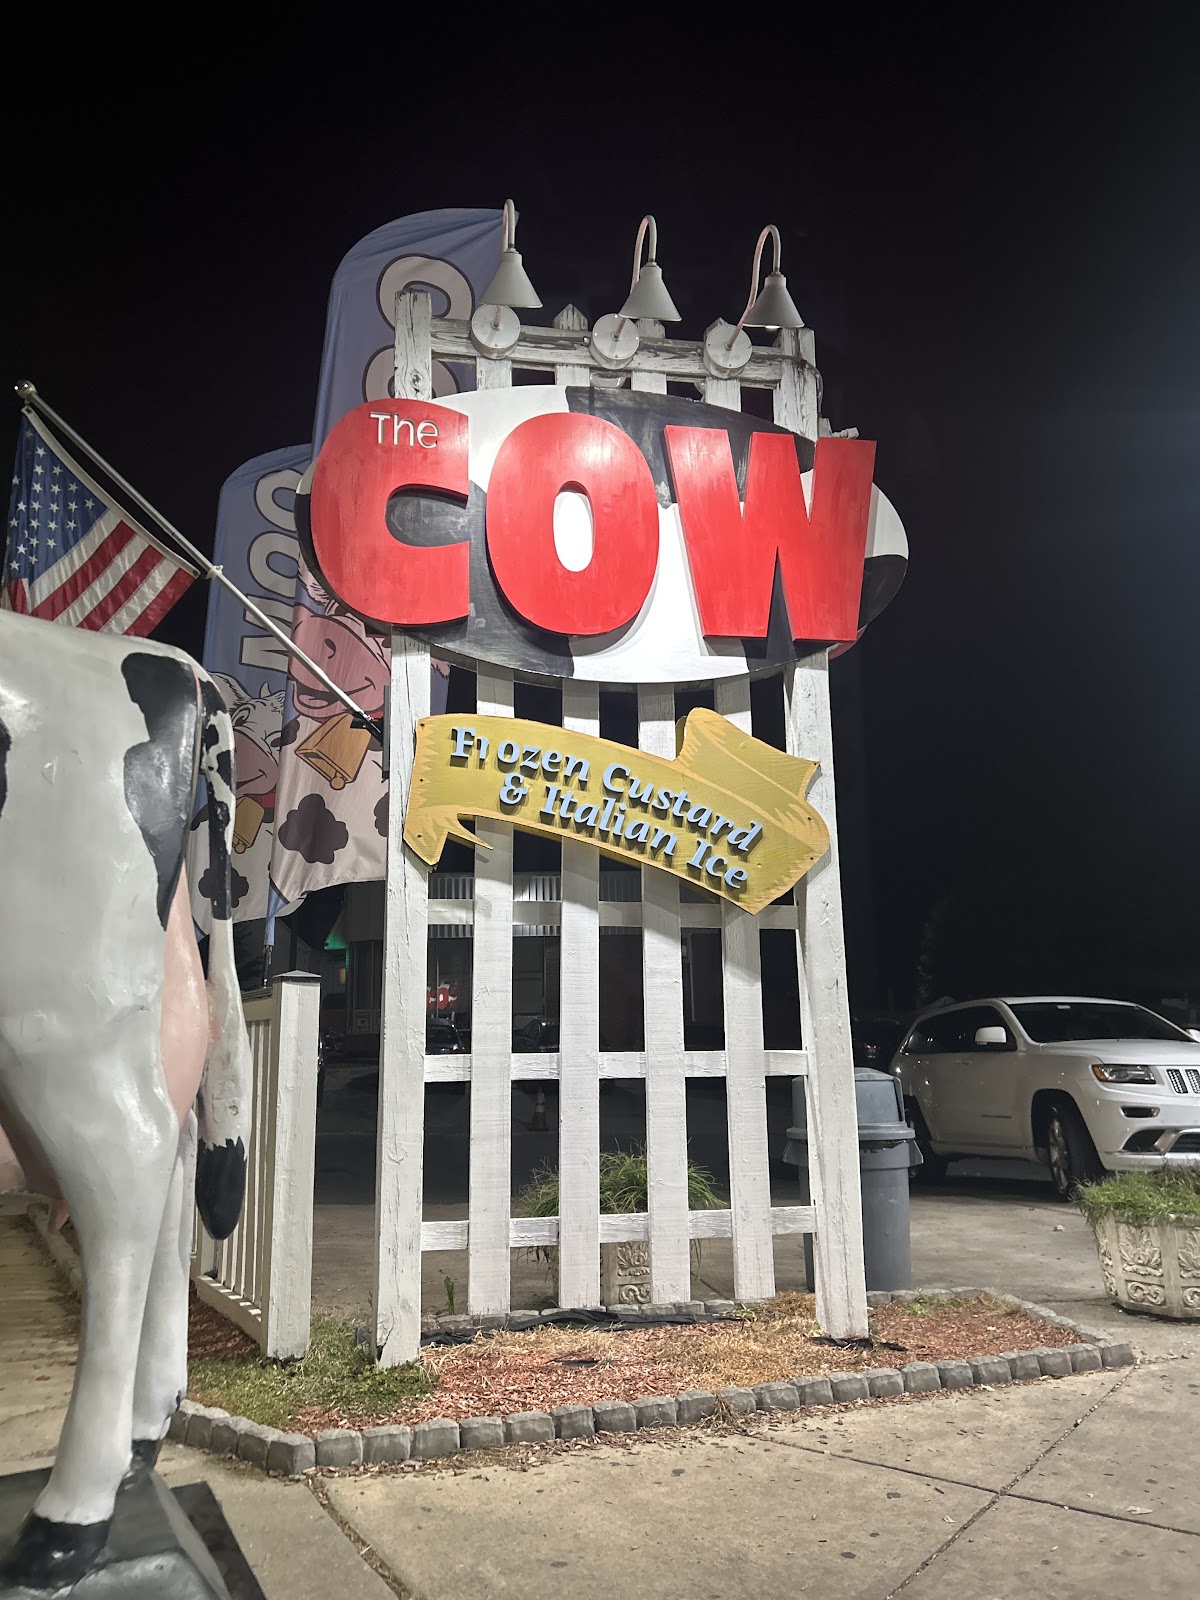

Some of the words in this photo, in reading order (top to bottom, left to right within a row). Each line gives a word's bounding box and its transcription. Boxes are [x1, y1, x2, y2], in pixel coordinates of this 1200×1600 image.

[369, 411, 438, 449] The
[310, 398, 877, 642] COW
[450, 727, 590, 781] Frozen
[602, 763, 763, 852] Custard
[499, 772, 529, 804] &
[540, 785, 678, 856] Italian
[686, 838, 749, 889] Ice
